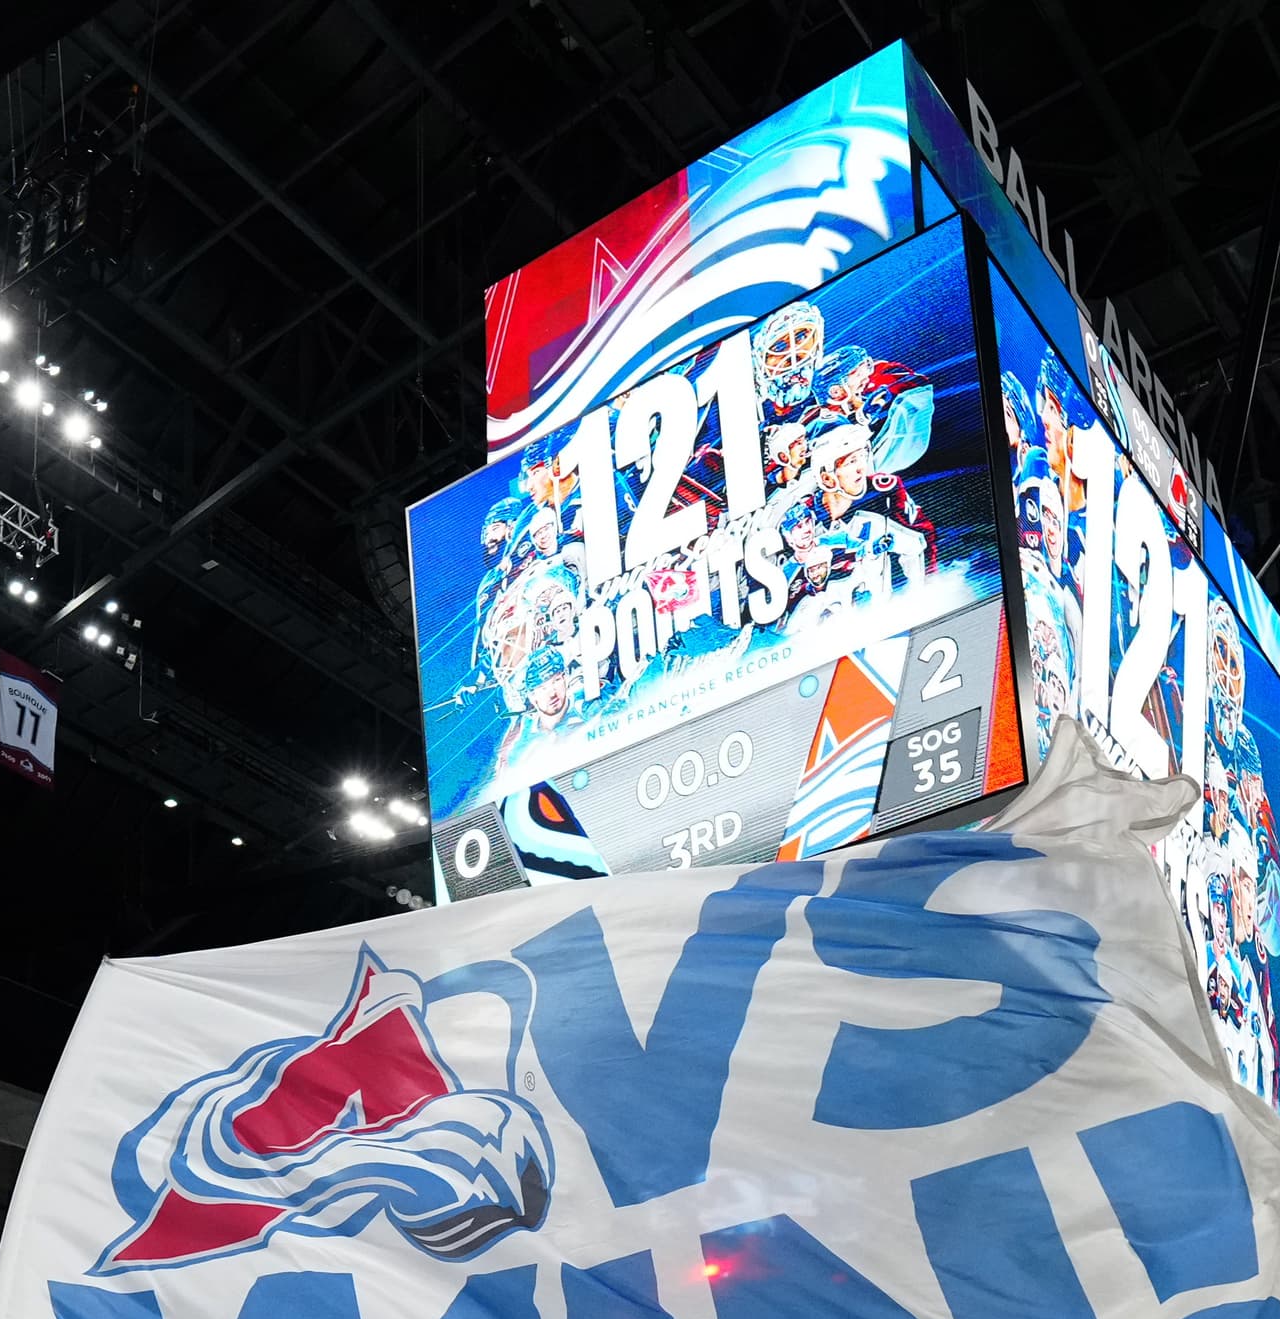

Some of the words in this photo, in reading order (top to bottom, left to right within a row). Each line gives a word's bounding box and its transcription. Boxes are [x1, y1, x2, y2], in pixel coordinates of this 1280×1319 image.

[967, 78, 1090, 319] BALL
[1102, 296, 1230, 528] ARENA
[555, 329, 766, 586] 121
[7, 686, 48, 715] BOURQUE
[587, 720, 619, 741] NEW
[627, 679, 717, 724] FRANCHISE
[725, 646, 793, 683] RECORD
[918, 637, 963, 703] 2
[15, 700, 42, 746] 77
[907, 724, 962, 759] SOG
[636, 730, 754, 810] 00.0
[911, 752, 962, 793] 35
[455, 829, 490, 879] 0
[662, 810, 743, 872] 3RD
